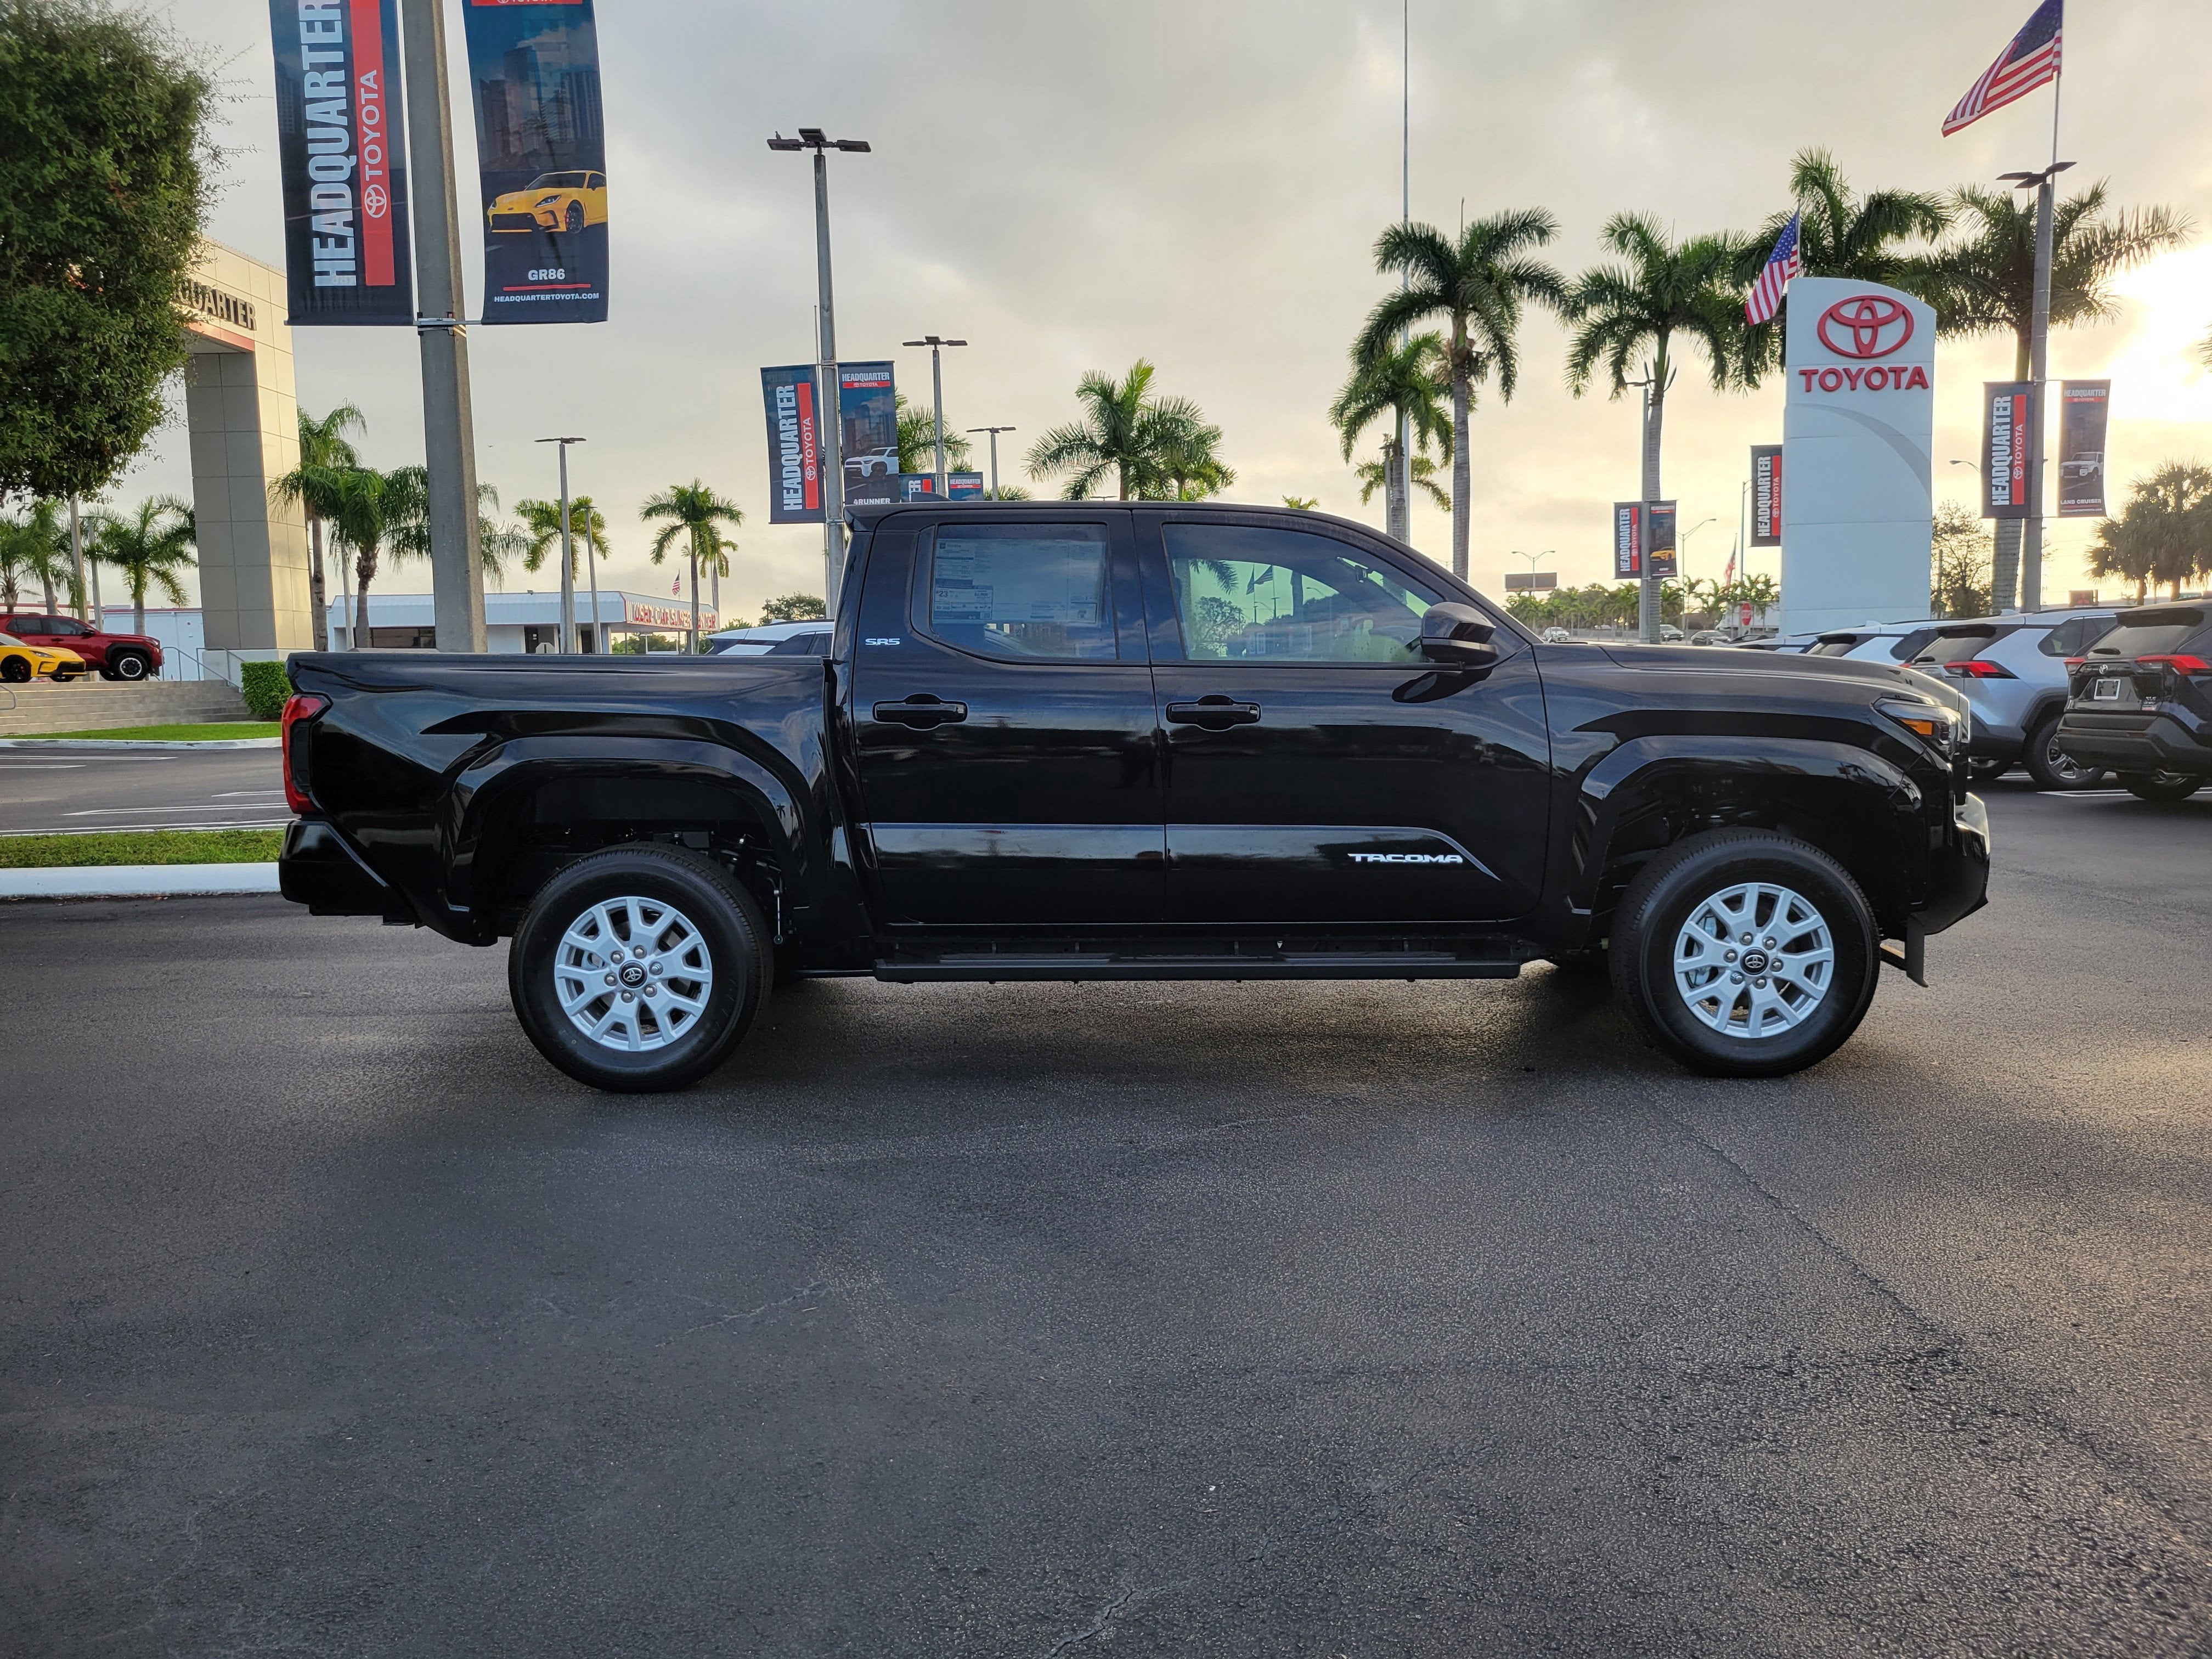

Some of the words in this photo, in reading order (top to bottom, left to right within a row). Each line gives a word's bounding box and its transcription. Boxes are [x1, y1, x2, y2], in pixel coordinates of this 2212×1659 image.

[298, 0, 357, 287] HEADQUARTER
[360, 70, 383, 182] TOYOTA
[528, 268, 566, 281] GR86
[494, 292, 600, 303] HEADQUARTERTOYOTA.COM
[842, 372, 890, 382] HEADQUARTER
[1798, 366, 1929, 393] TOYOTA
[2064, 388, 2107, 397] HEADQUARTER
[776, 385, 803, 511] HEADQUARTER
[803, 417, 815, 465] TOYOTA
[1991, 396, 2013, 506] HEADQUARTER
[2015, 424, 2023, 466] TOYOTA
[1757, 456, 1772, 537] HEADQUARTER
[1619, 508, 1631, 572] HEADQUARTER
[1347, 853, 1464, 864] TACOMA
